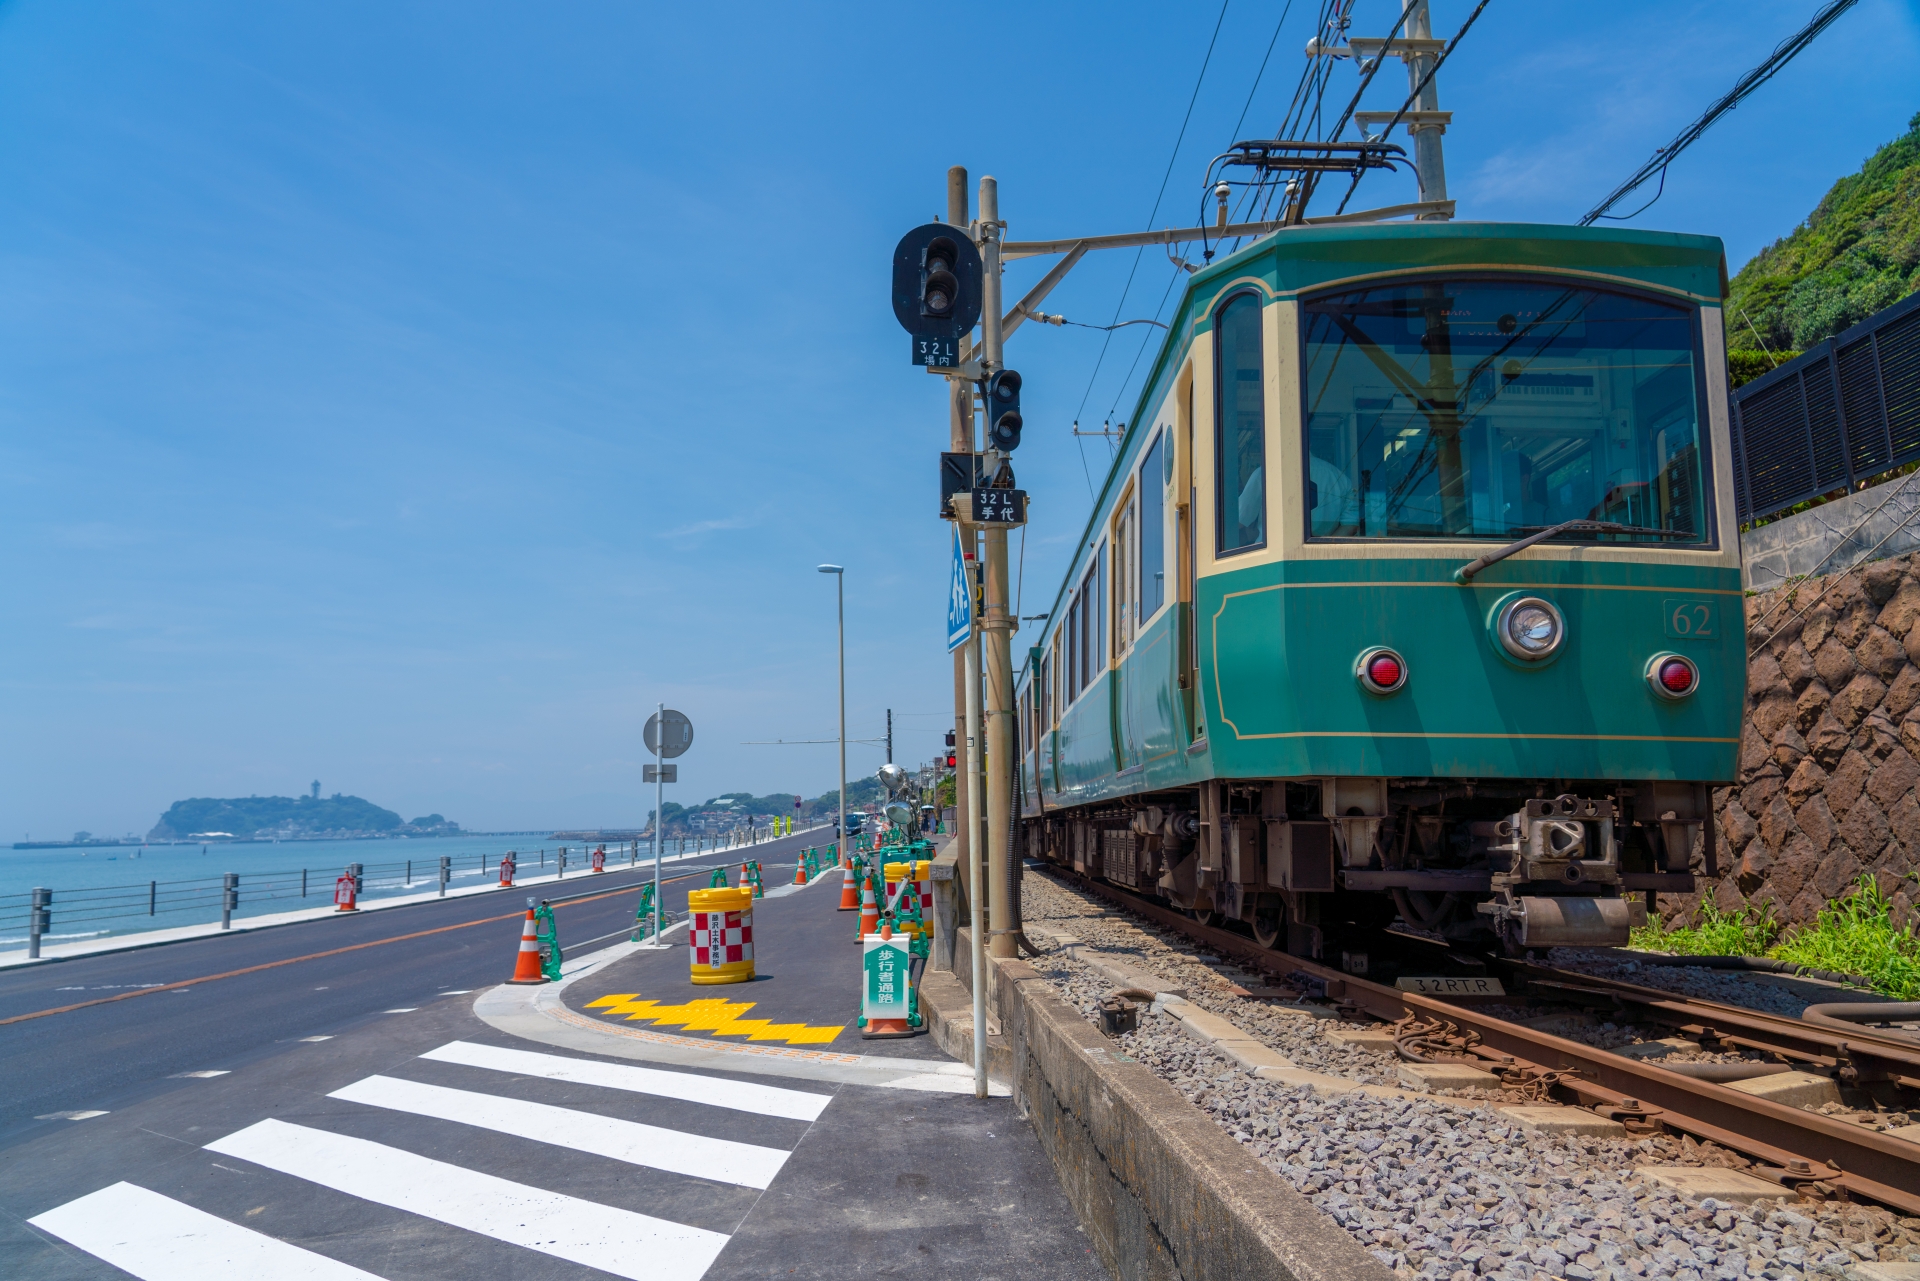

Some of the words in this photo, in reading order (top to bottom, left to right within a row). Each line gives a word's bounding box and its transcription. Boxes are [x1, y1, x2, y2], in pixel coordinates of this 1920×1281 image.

[920, 341, 953, 356] 32L
[924, 355, 950, 366] 場内
[980, 493, 1012, 505] 32L
[981, 506, 1015, 522] 手代
[1672, 604, 1712, 635] 62
[711, 914, 721, 967] 藤沢土木事務所
[878, 950, 895, 1004] 歩行者通路
